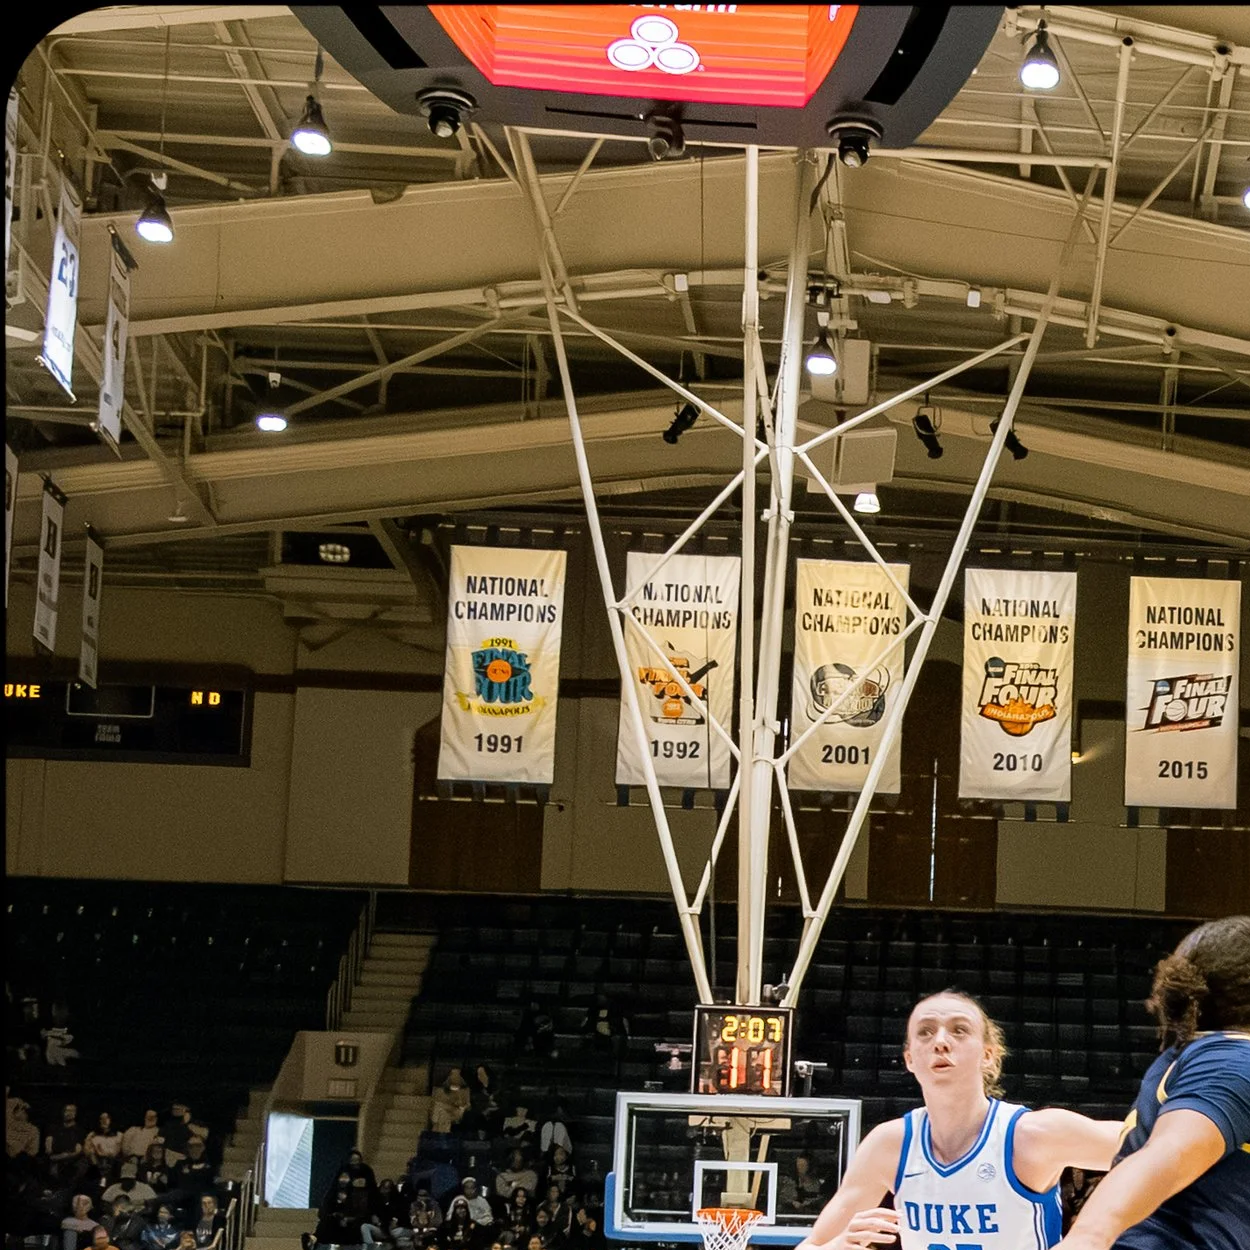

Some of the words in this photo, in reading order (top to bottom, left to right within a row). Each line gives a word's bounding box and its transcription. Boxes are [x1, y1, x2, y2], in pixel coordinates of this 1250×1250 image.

[466, 575, 549, 597] NATIONAL
[813, 588, 893, 611] NATIONAL
[981, 597, 1060, 618] NATIONAL
[455, 600, 557, 623] CHAMPIONS
[631, 605, 732, 630] CHAMPIONS
[1146, 605, 1225, 627] NATIONAL
[802, 612, 901, 636] CHAMPIONS
[971, 622, 1069, 644] CHAMPIONS
[1136, 629, 1234, 652] CHAMPIONS
[1003, 662, 1058, 686] FINAL
[980, 677, 1057, 710] FOUR
[1173, 679, 1228, 699] FINAL
[1152, 694, 1226, 725] FOUR
[474, 733, 523, 753] 1991
[651, 739, 700, 759] 1992
[821, 744, 870, 765] 2001
[993, 752, 1043, 772] 2010
[1158, 760, 1208, 780] 2015
[722, 1015, 781, 1043] 2:07
[904, 1200, 999, 1234] DUKE
